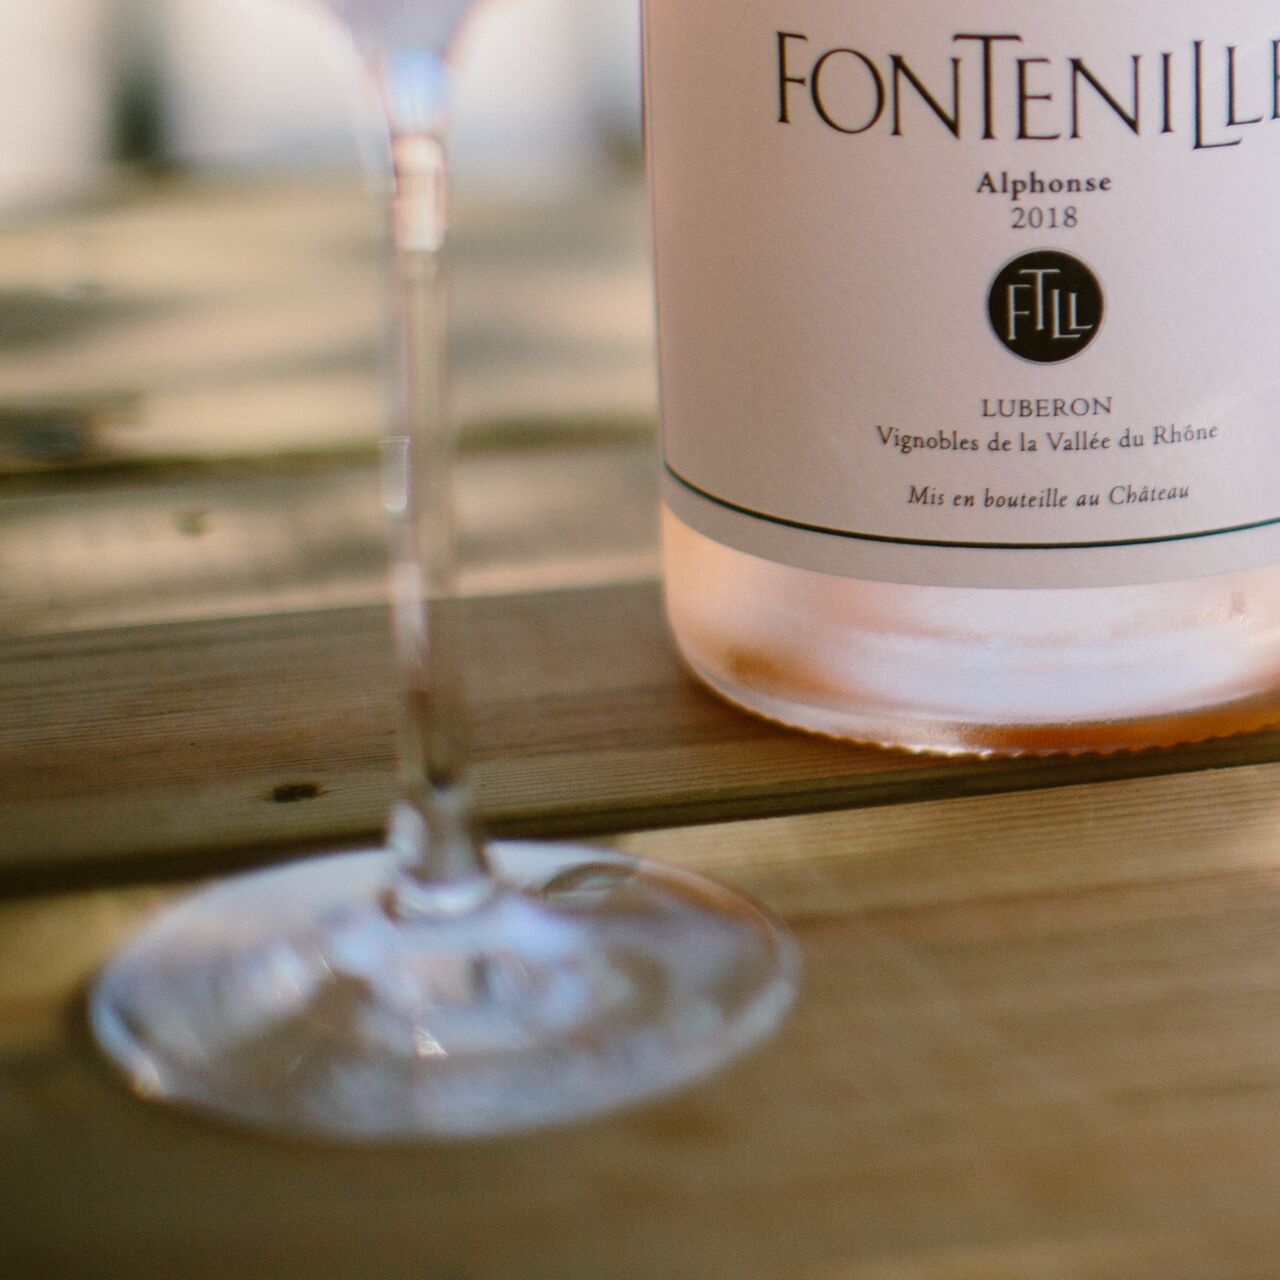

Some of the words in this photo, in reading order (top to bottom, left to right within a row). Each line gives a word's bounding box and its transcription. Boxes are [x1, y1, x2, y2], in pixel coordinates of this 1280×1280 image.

[976, 170, 1112, 201] Alphonse
[1010, 205, 1079, 230] 2018
[1006, 267, 1093, 341] FTLL
[981, 396, 1113, 418] LUBERON
[875, 424, 980, 455] Vignobles
[986, 431, 1012, 452] de
[1019, 431, 1038, 453] la
[1045, 430, 1111, 452] Vallée
[1118, 427, 1145, 449] du
[1152, 423, 1218, 446] Rhône
[906, 484, 945, 506] Mis
[952, 494, 975, 508] en
[983, 487, 1069, 509] bouteille
[1075, 493, 1101, 508] au
[1107, 484, 1190, 506] Château
